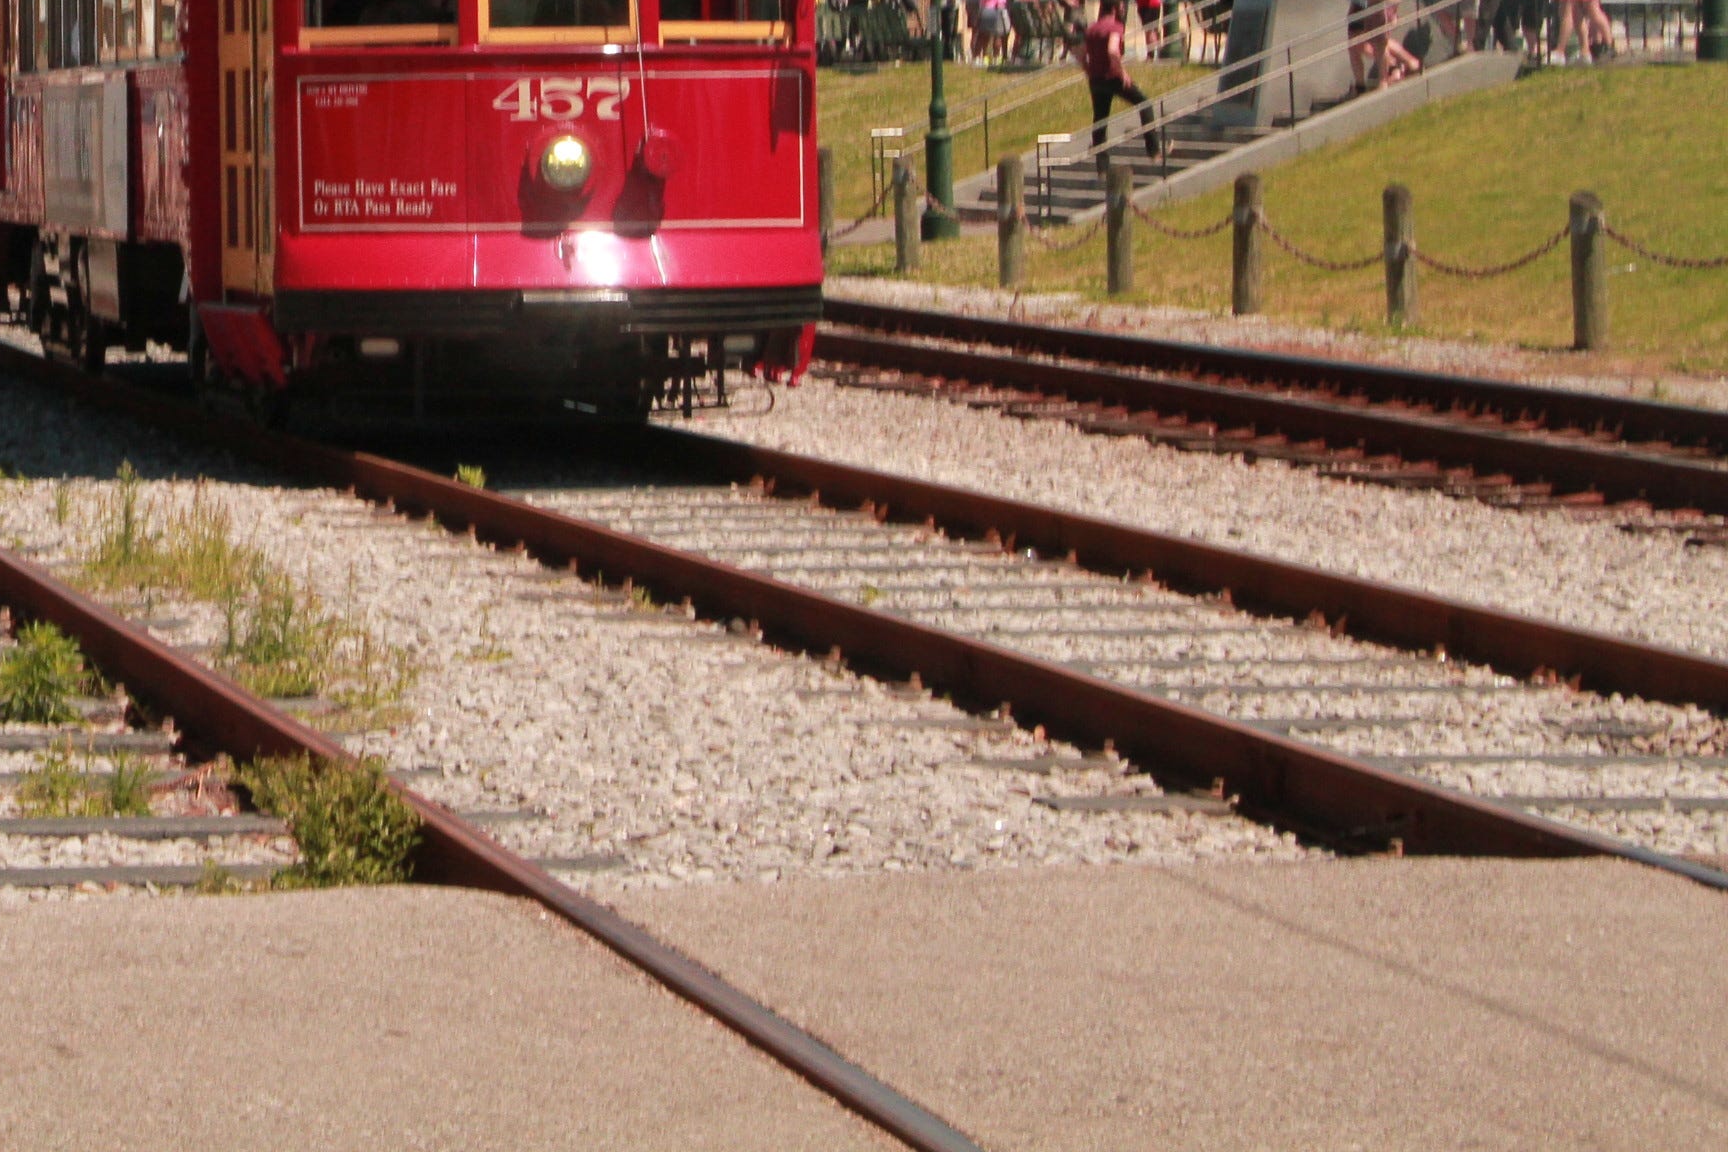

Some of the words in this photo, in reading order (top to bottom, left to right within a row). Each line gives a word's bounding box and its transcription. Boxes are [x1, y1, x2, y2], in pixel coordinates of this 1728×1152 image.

[492, 76, 630, 122] 457
[314, 178, 350, 196] Please
[355, 178, 385, 196] Have
[390, 178, 425, 196] Exact
[431, 178, 457, 197] Fare
[314, 199, 328, 216] Or
[334, 199, 359, 216] RTA
[365, 199, 391, 216] Pass
[396, 199, 433, 218] Ready
